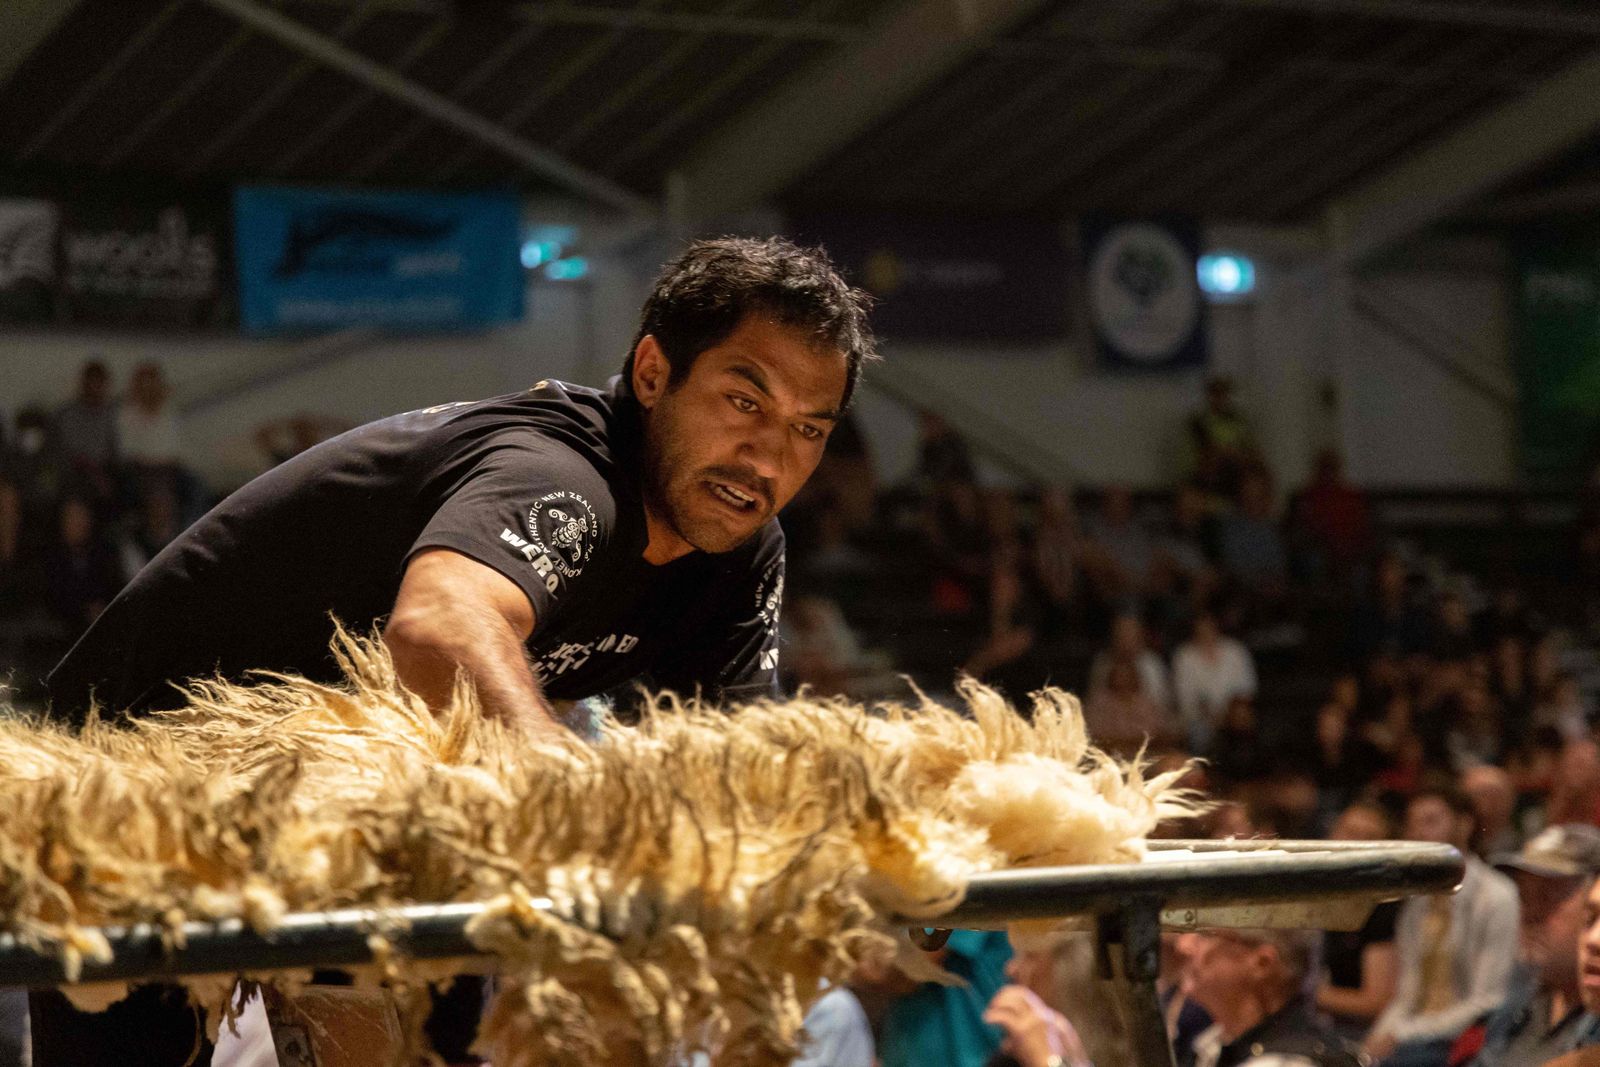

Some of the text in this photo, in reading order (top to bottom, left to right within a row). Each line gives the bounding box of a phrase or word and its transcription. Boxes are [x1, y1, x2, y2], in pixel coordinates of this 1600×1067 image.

[541, 490, 565, 502] NEW
[568, 491, 598, 538] ZEALAND
[499, 527, 559, 593] WERO
